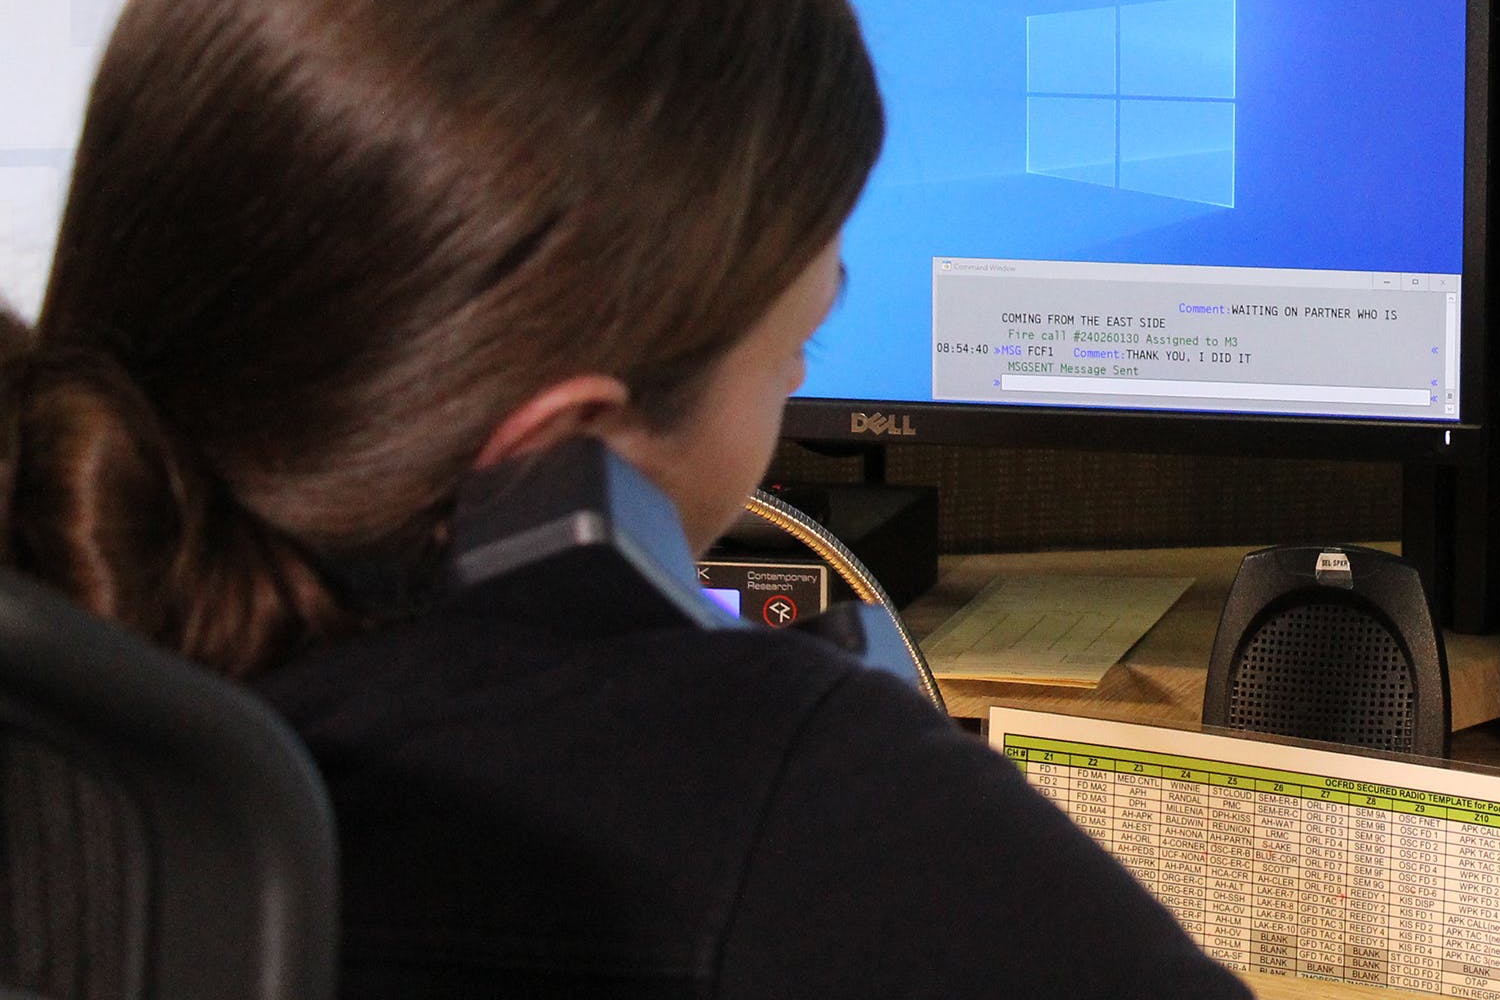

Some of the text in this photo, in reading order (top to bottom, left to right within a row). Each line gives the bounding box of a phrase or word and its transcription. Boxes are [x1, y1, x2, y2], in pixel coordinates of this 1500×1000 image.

[1284, 305, 1298, 317] ON
[1304, 306, 1351, 319] PARTNER
[1357, 308, 1378, 320] WHO
[1384, 309, 1397, 320] IS
[1001, 313, 1165, 329] COMING FROM THE EAST SIDE
[936, 343, 988, 355] 08:54:40
[1008, 361, 1138, 377] MSGSENT Message Sent
[748, 571, 817, 583] Contemporary
[748, 581, 793, 591] Research
[1170, 781, 1200, 793] WINNIE
[1213, 787, 1252, 800] STCLOUD
[1325, 777, 1431, 799] OCFRD SECURED RADIO
[1428, 795, 1475, 809] TEMPLATE
[1477, 802, 1486, 811] for
[1165, 816, 1204, 828] BALDWIN
